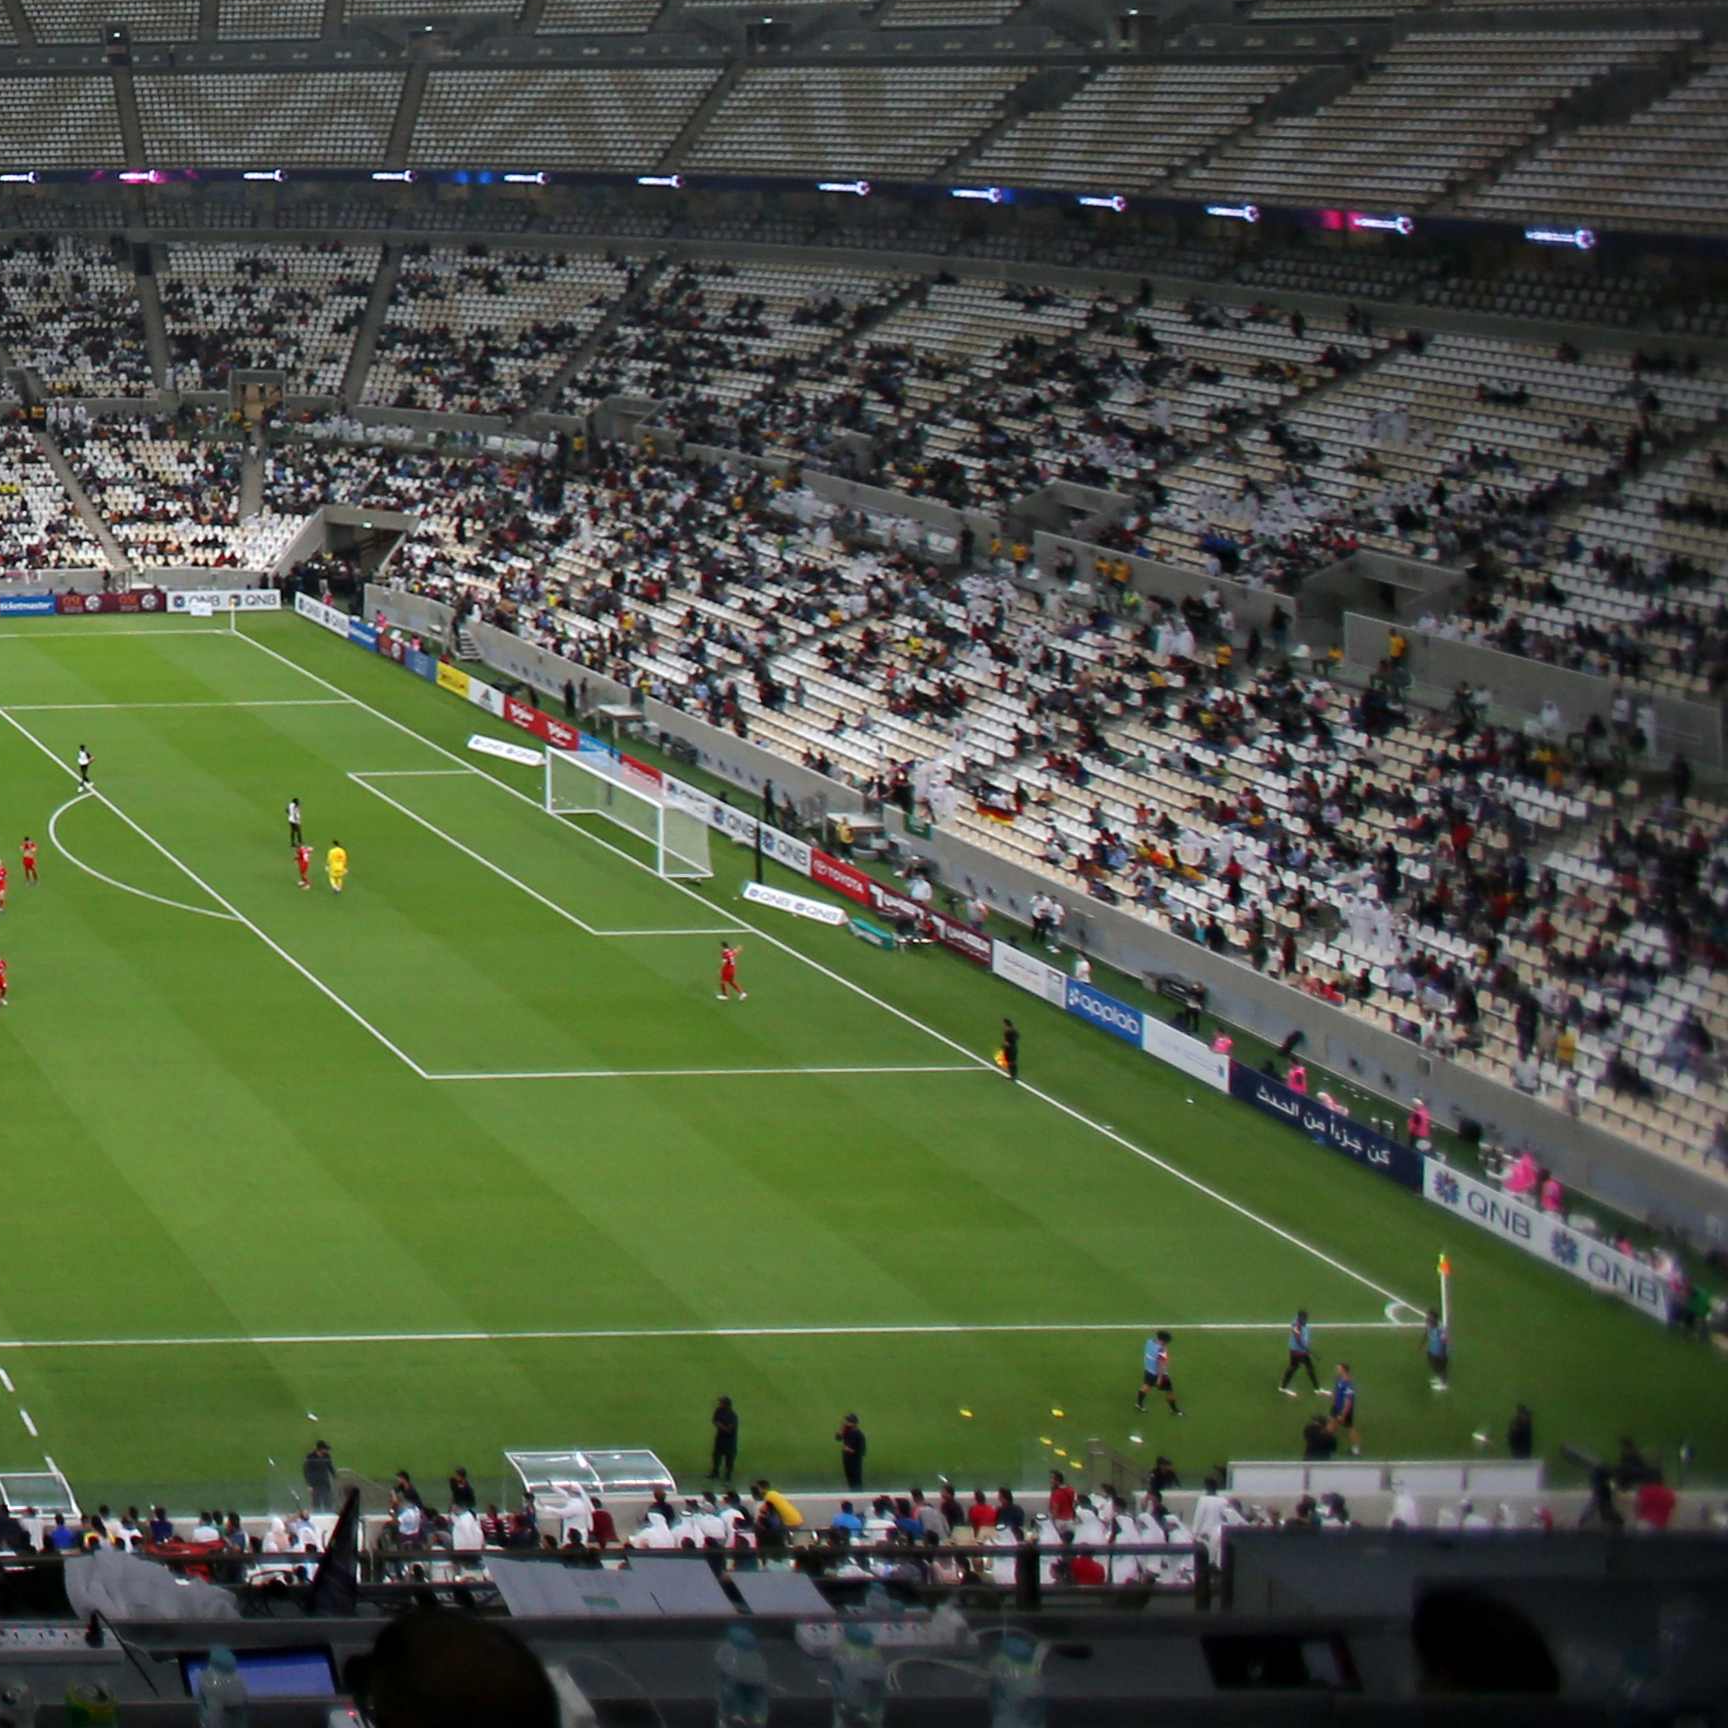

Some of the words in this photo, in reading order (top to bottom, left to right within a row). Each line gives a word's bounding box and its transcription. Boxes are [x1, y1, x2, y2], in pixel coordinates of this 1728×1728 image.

[245, 594, 276, 605] QNB
[828, 865, 864, 894] TOYOTA
[1080, 992, 1140, 1035] applab
[1467, 1190, 1531, 1239] QNB
[1586, 1251, 1659, 1306] QNB
